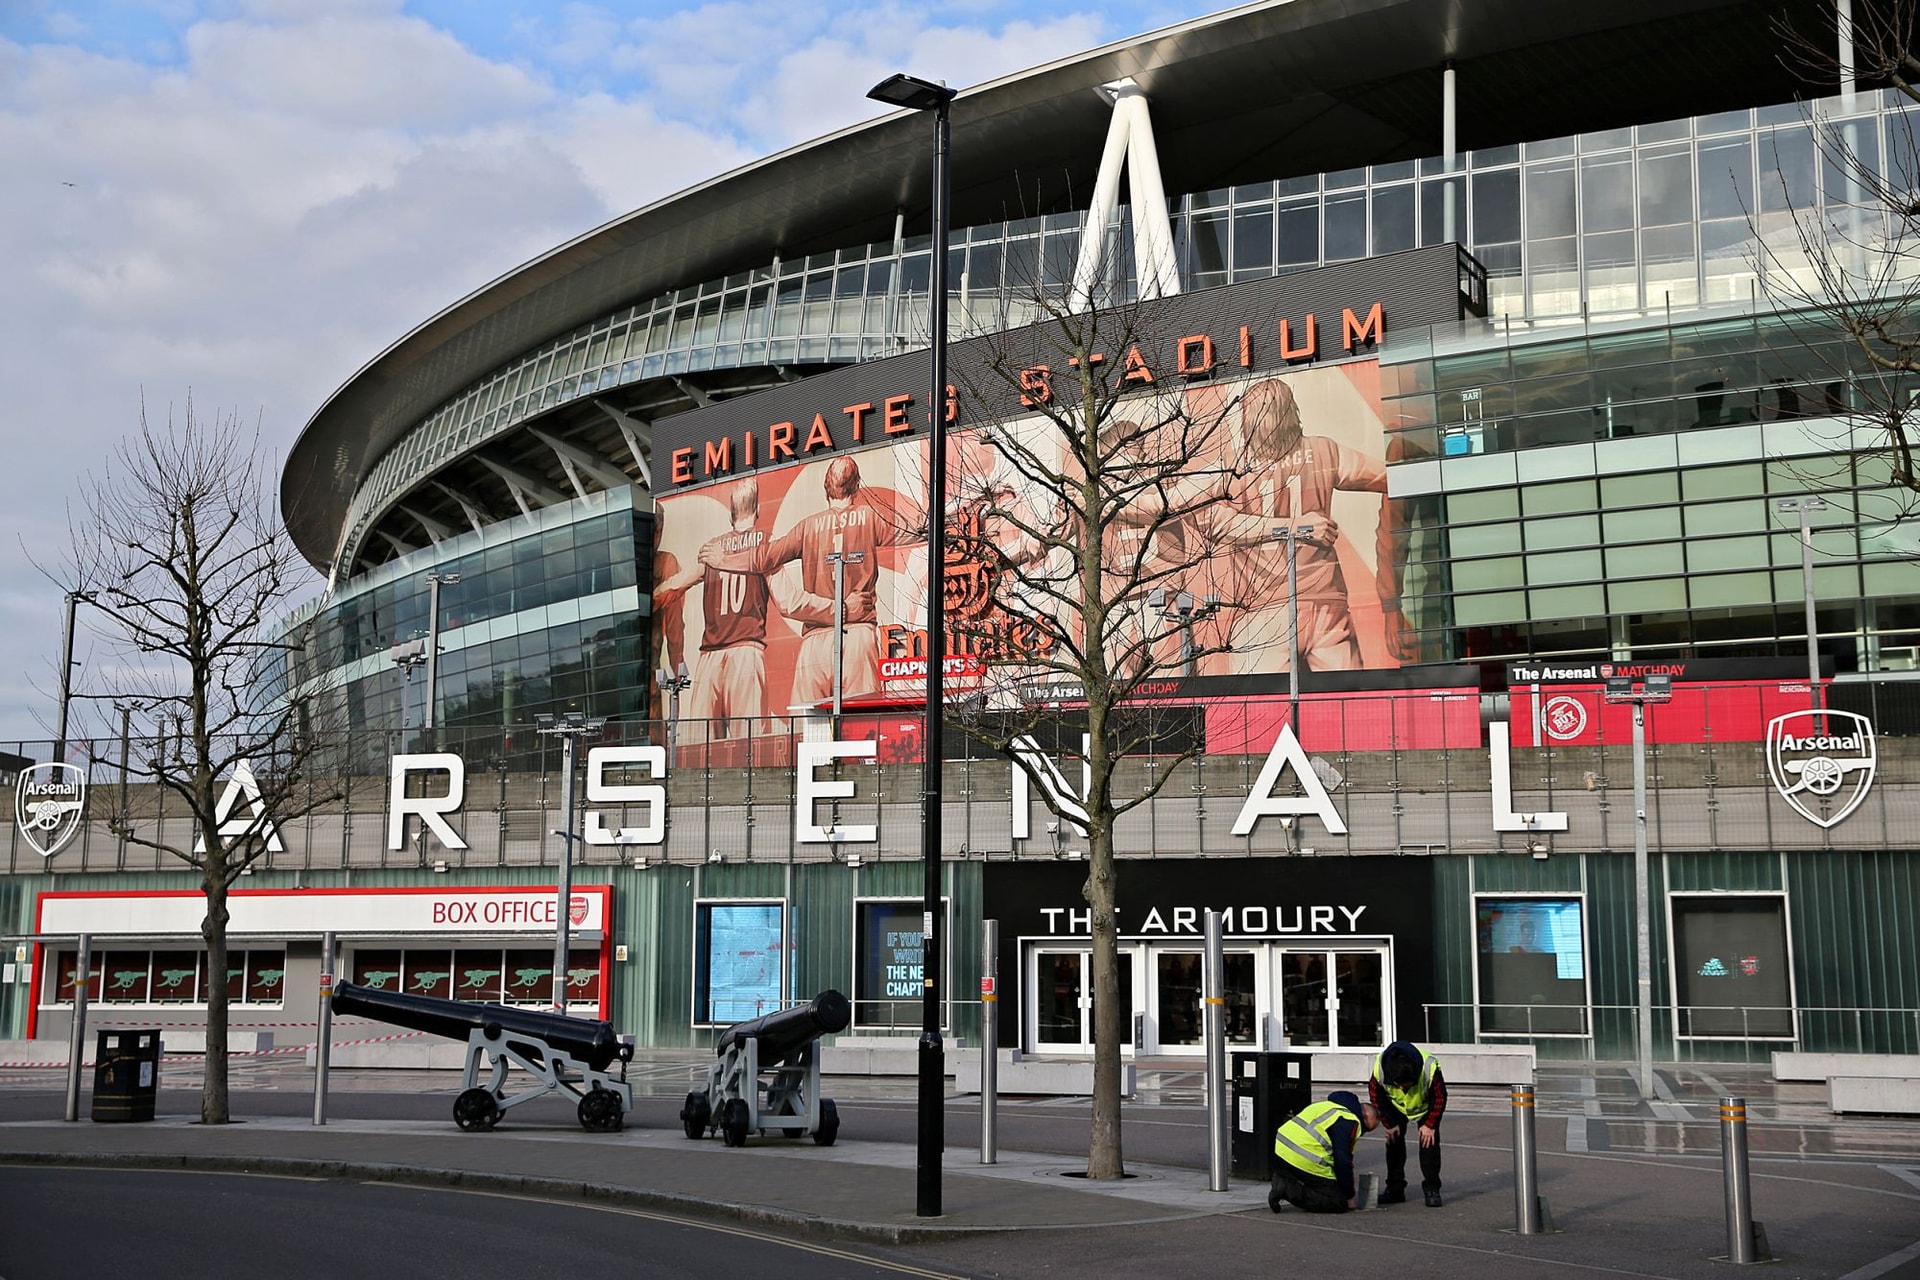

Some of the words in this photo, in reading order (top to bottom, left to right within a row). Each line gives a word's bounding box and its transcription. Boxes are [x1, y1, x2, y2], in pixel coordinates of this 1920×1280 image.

[814, 509, 867, 533] WILSON
[719, 571, 747, 616] 10
[881, 657, 966, 677] CHAPMN'S
[1513, 667, 1539, 681] The
[1542, 665, 1598, 680] Arsenal
[1617, 664, 1686, 677] MATCHDAY
[1051, 685, 1085, 698] Arse
[1127, 681, 1179, 696] ATCHDAY
[1552, 709, 1575, 729] BUY
[1780, 732, 1862, 751] Arsenal
[25, 781, 76, 796] Arsenal
[433, 901, 478, 923] BOX
[484, 900, 557, 923] OFFICE
[1040, 907, 1121, 934] TH
[1140, 905, 1367, 934] ARMOURY
[887, 931, 898, 947] IF
[893, 948, 924, 964] WRIT
[886, 965, 907, 980] THE
[909, 965, 924, 980] NE
[886, 981, 925, 997] CHAPT
